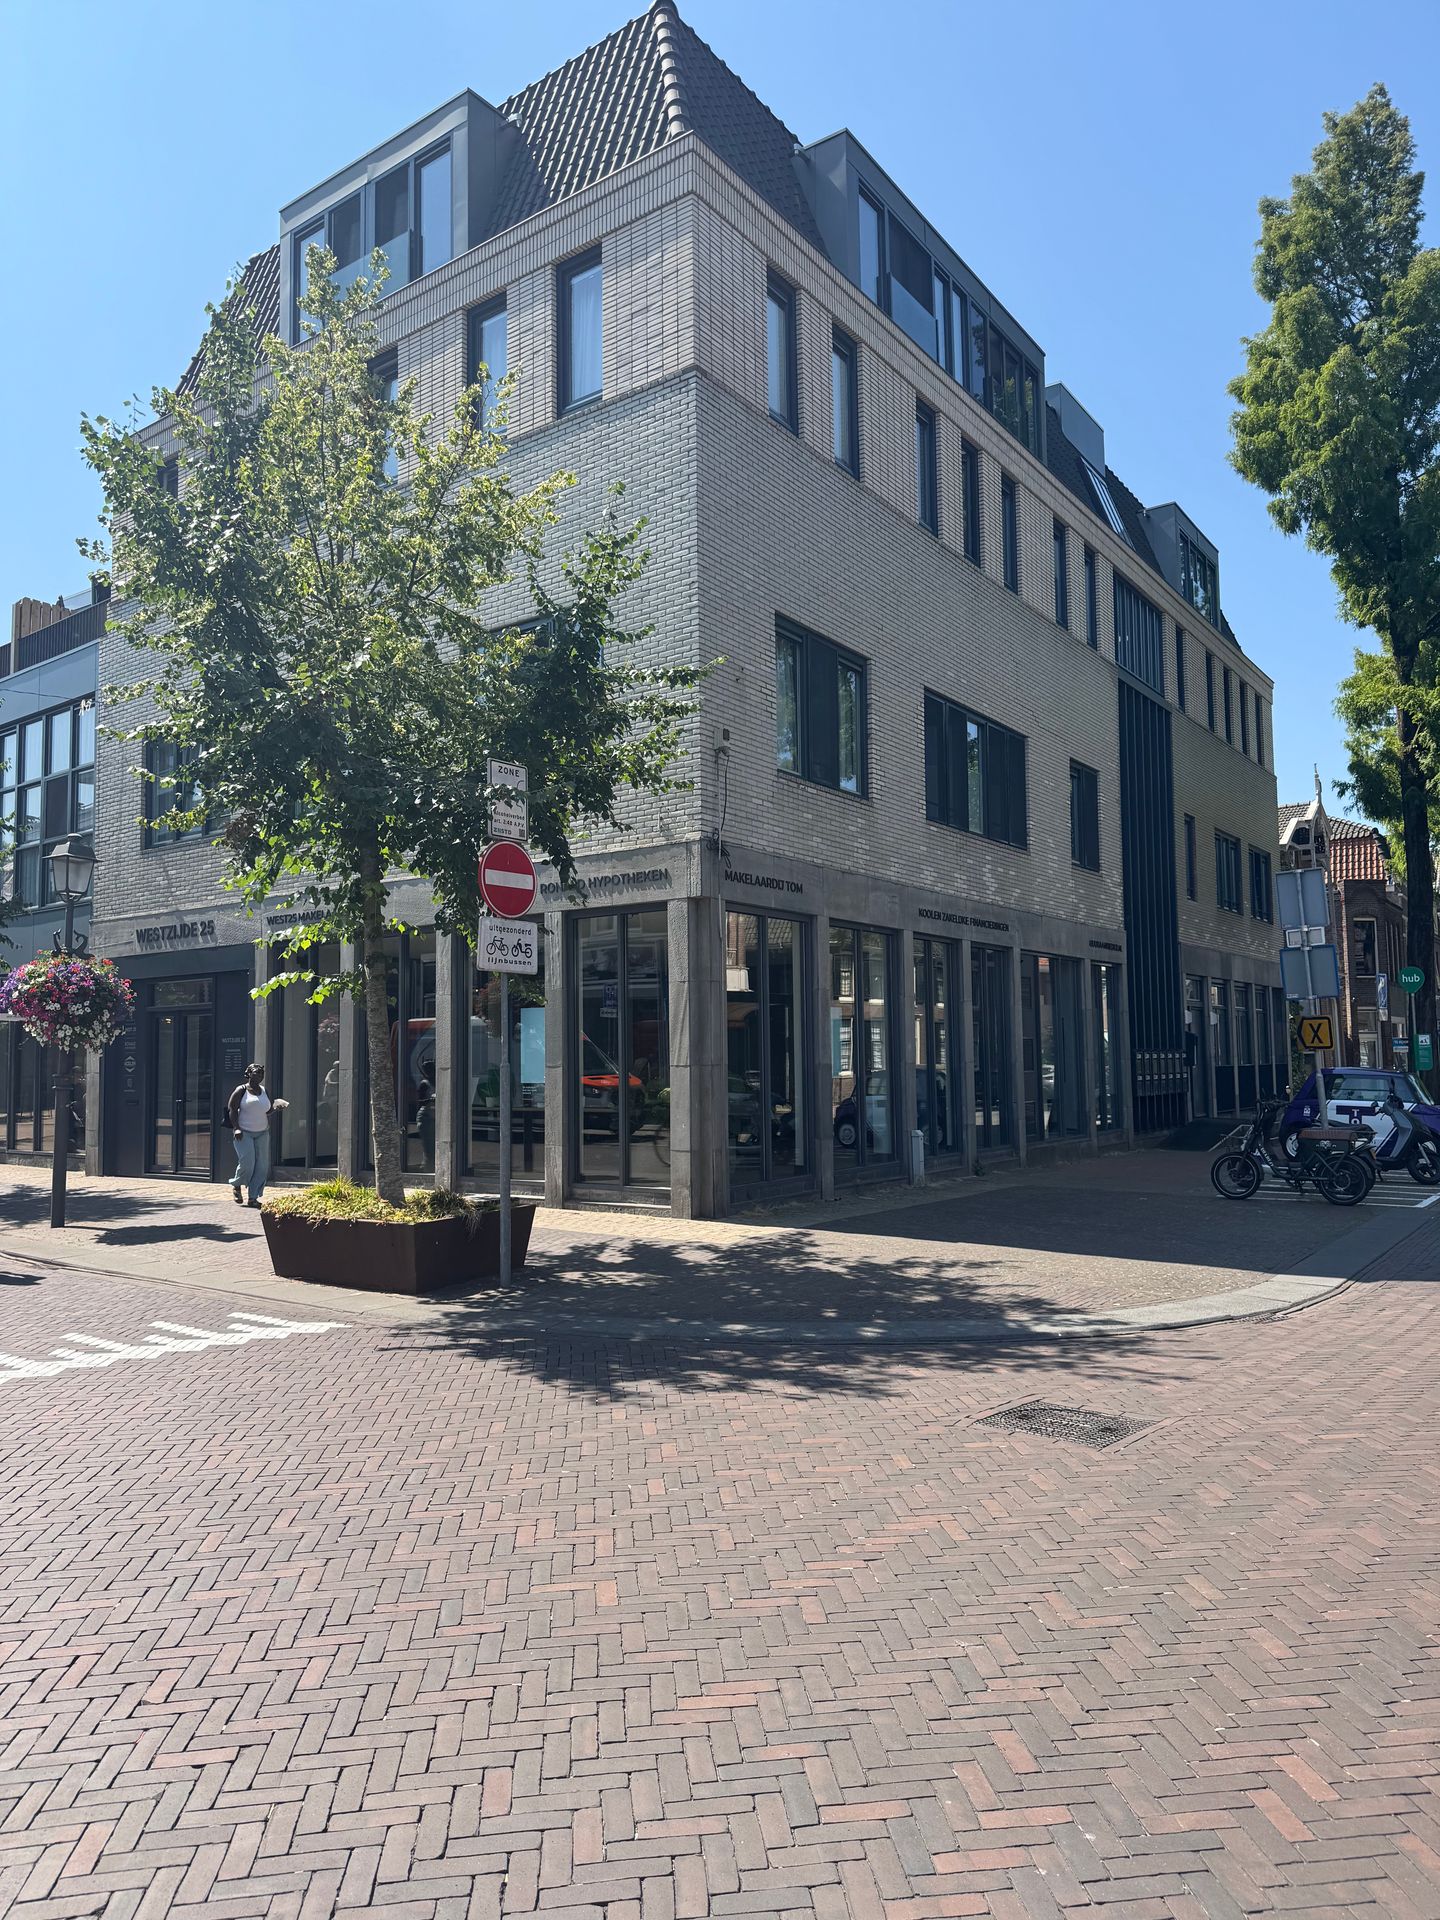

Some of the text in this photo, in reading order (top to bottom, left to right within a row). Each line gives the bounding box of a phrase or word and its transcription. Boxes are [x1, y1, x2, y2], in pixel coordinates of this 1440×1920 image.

[498, 765, 520, 777] ZONE
[540, 868, 669, 895] ROND HYPOTHEKEN
[725, 869, 803, 894] MAKELAARDIJ TOM
[266, 909, 333, 926] WEST25 MAKELA
[918, 907, 941, 920] KOOLEN
[136, 920, 215, 943] WESTZIJDE 25
[489, 924, 531, 935] uitgezonderd
[487, 956, 532, 966] lijnbussen
[1401, 973, 1420, 983] hub
[1308, 1022, 1324, 1044] X
